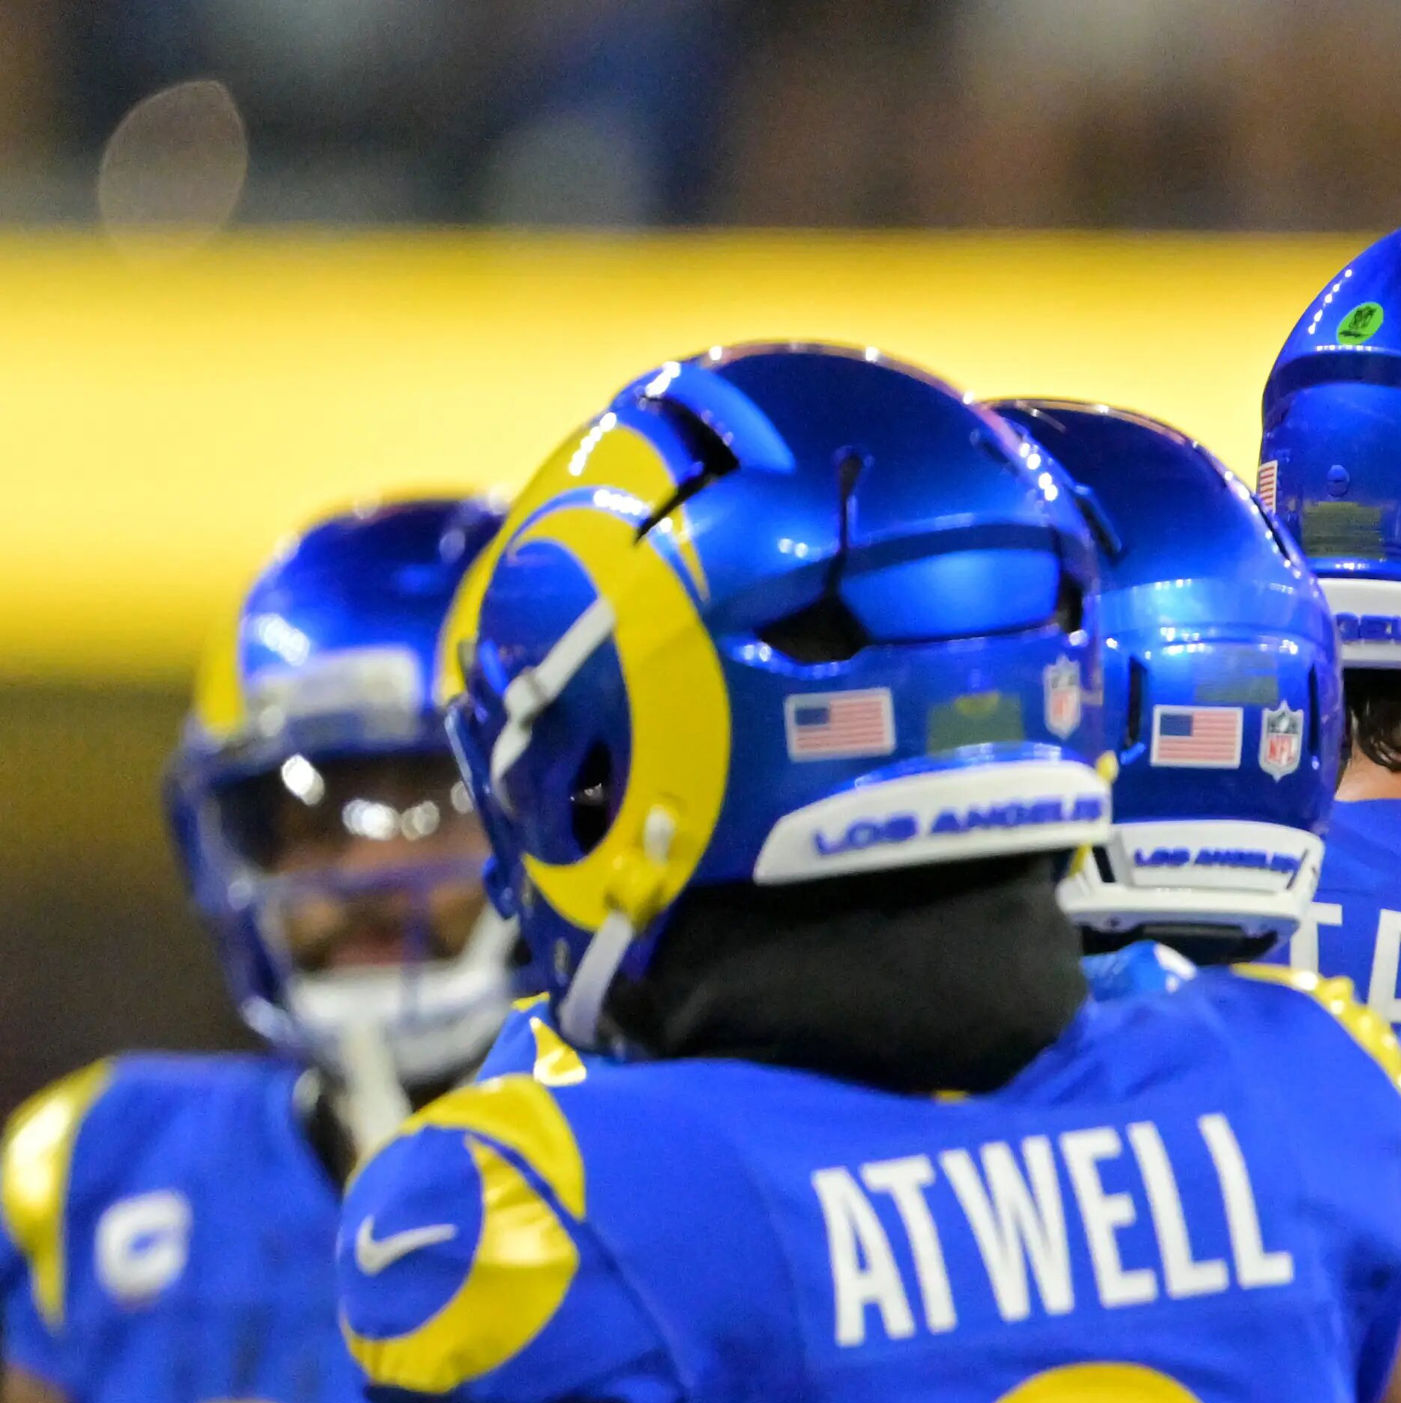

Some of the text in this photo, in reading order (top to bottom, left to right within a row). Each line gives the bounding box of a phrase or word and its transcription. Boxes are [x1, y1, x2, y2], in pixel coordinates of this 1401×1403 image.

[815, 816, 917, 854] LOS
[1134, 848, 1190, 867] LOS
[811, 1111, 1294, 1347] ATWELL
